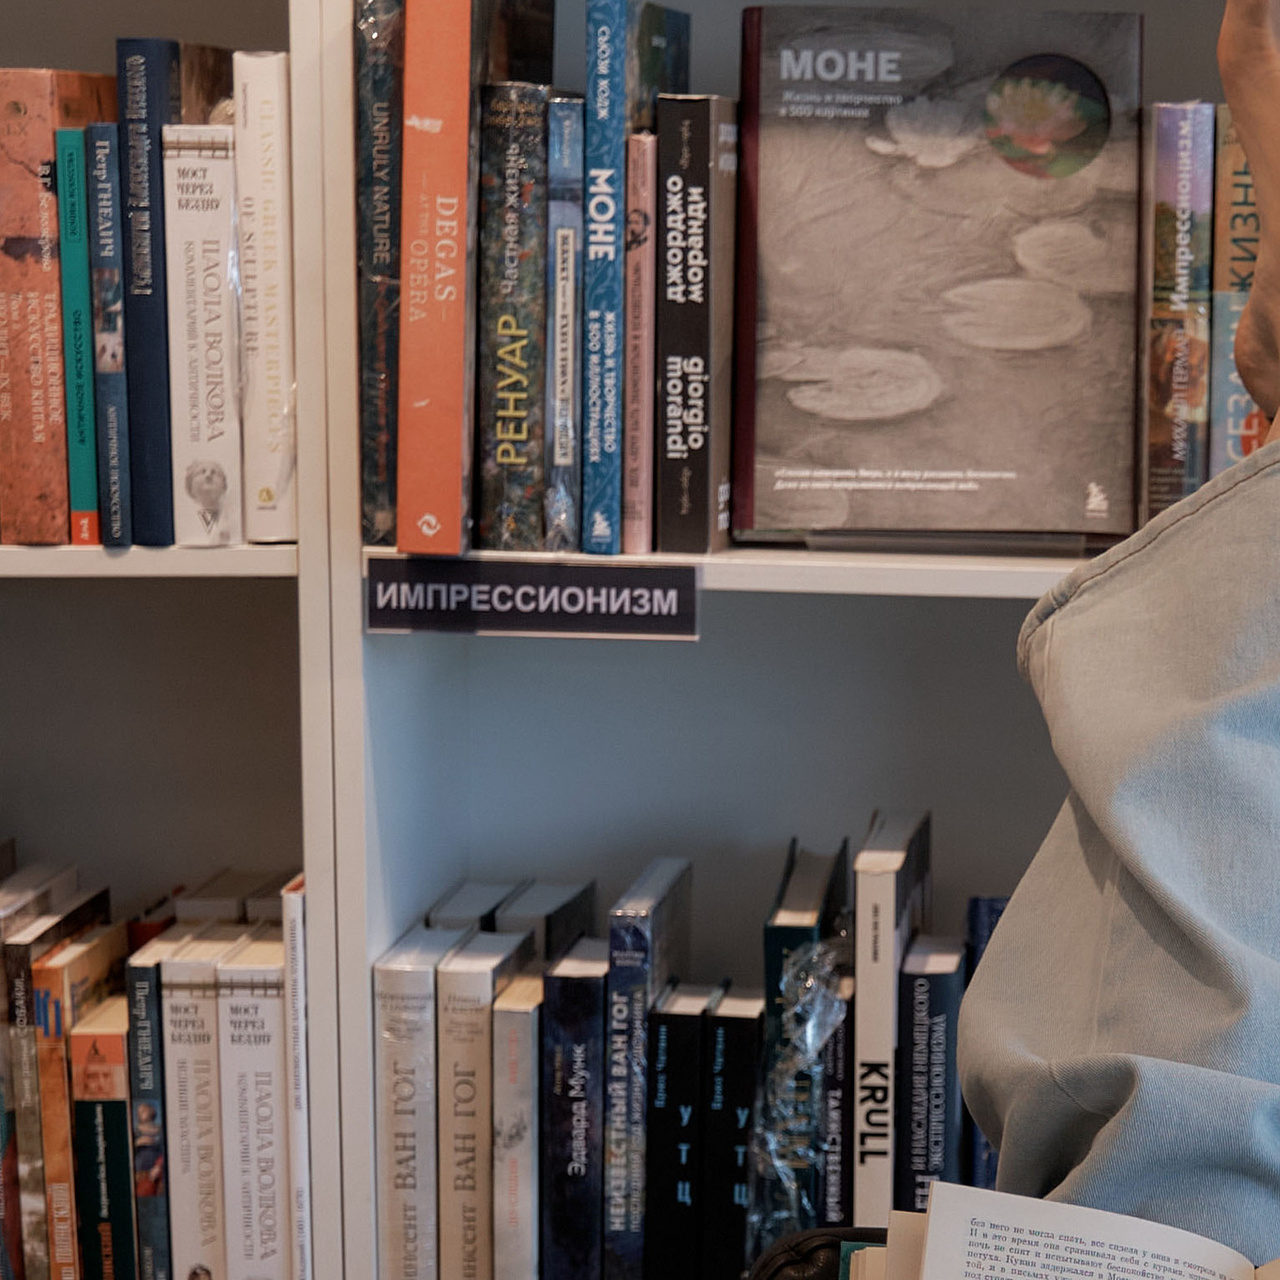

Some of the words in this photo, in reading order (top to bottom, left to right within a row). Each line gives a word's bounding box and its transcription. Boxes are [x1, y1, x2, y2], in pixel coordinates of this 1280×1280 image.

[780, 49, 902, 83] МОНЕ
[370, 102, 390, 182] UNRULY
[504, 142, 522, 209] жизнь
[372, 186, 391, 265] NATURE
[434, 195, 458, 302] DEGAS
[501, 211, 520, 295] Частная
[588, 169, 616, 261] МОНЕ
[665, 174, 688, 304] джорджо
[686, 186, 709, 303] моранди
[1170, 118, 1194, 312] Импрессионизм
[202, 239, 223, 327] ПАОЛА
[242, 232, 259, 358] SCULPTURE
[603, 311, 617, 356] ЖИЗНЬ
[204, 331, 226, 443] ВОЛКОВА
[496, 313, 529, 465] РЕНУАР
[602, 370, 616, 454] ТВОРЧЕСТВО
[665, 356, 688, 460] morandi
[685, 356, 708, 451] giorgio
[376, 582, 679, 616] ИМПРЕССИОНИЗМ
[609, 992, 630, 1031] ГОГ
[394, 1061, 417, 1117] ГОГ
[452, 1061, 477, 1119] ГОГ
[566, 1044, 588, 1098] Мунк
[609, 1035, 629, 1076] ВАН
[567, 1100, 588, 1177] Эдвард
[607, 1079, 630, 1232] НЕИЗВЕСТНЫЙ
[861, 1061, 889, 1166] KRULL
[393, 1131, 417, 1191] ВАН
[453, 1132, 477, 1192] ВАН
